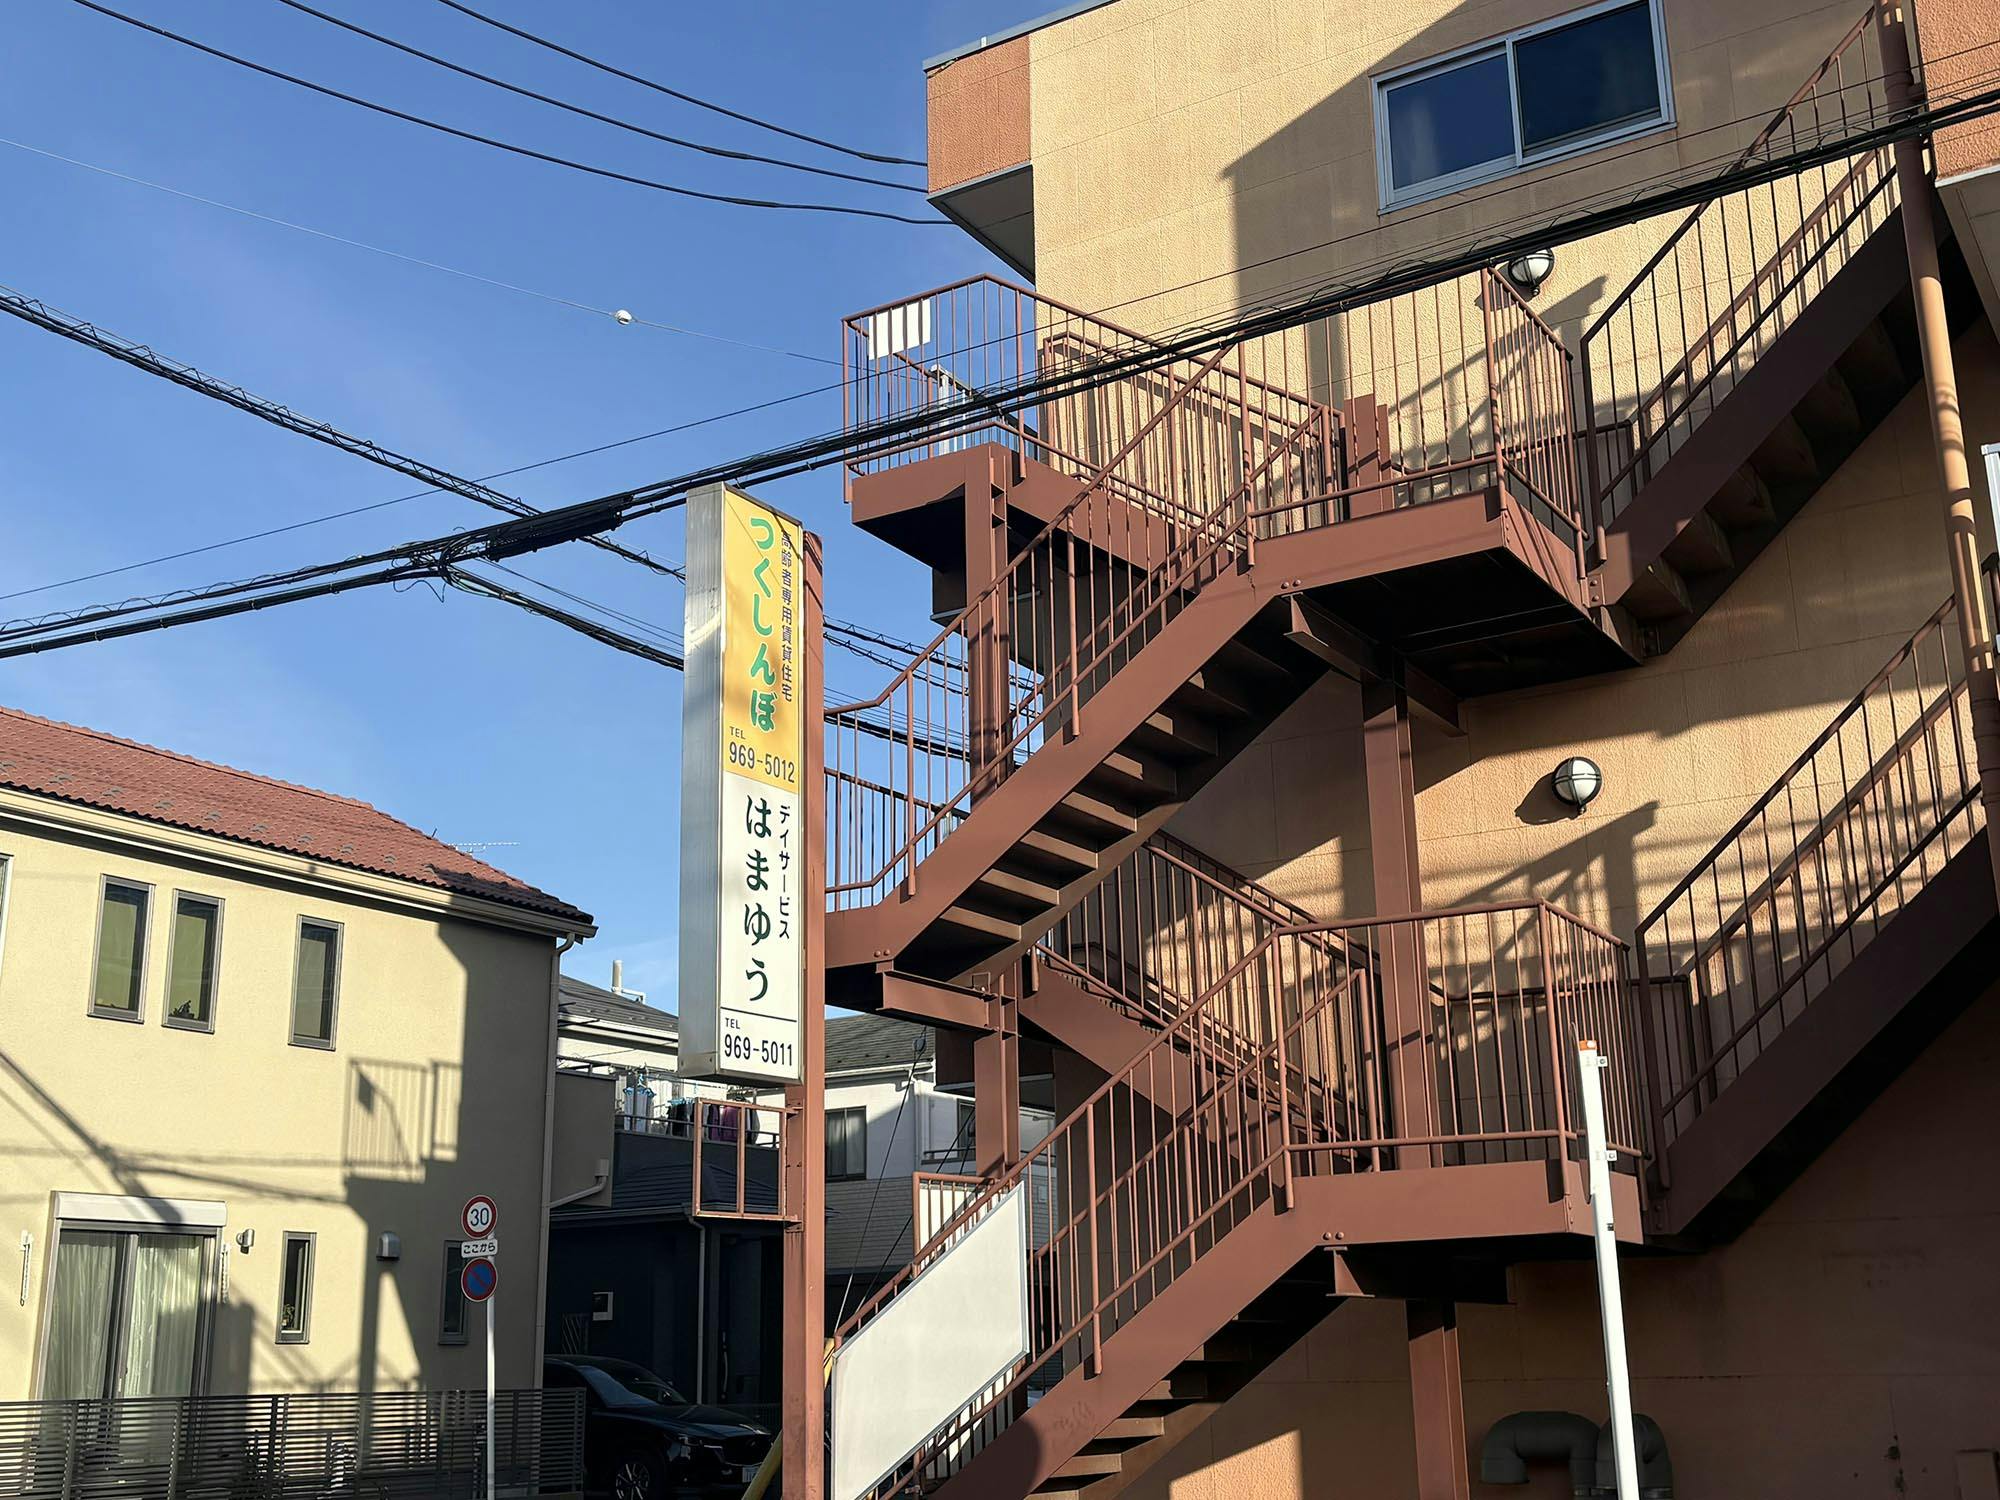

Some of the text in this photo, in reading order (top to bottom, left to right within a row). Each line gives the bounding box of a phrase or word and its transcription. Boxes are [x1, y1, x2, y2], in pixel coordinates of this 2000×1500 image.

[750, 517, 777, 732] つくしんぼ
[780, 531, 793, 703] 高齢者専用賃貸住宅
[729, 726, 746, 740] TEL
[729, 741, 795, 783] 969-5012
[778, 805, 790, 939] デイサービス
[745, 794, 772, 1002] はまゆう
[725, 1017, 741, 1030] TEL
[724, 1033, 793, 1066] 969-5011
[470, 1207, 489, 1226] 30
[463, 1242, 496, 1254] ここから
